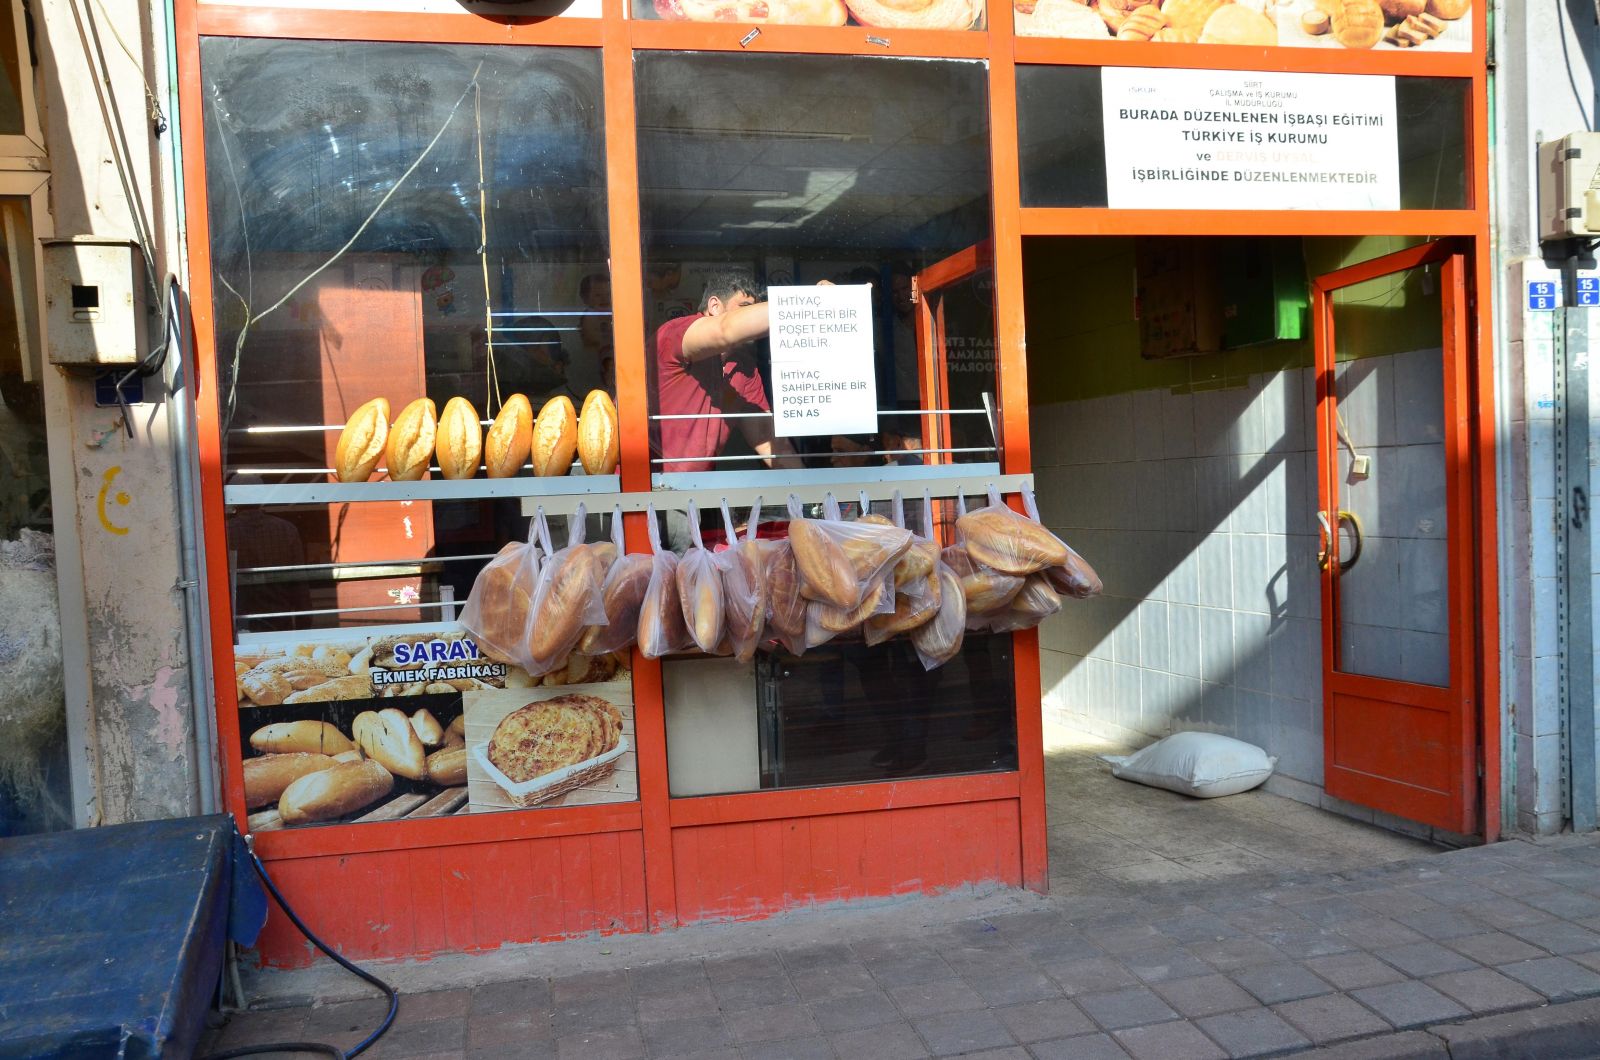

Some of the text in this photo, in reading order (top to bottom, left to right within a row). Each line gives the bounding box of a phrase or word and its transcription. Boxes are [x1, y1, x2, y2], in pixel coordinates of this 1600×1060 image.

[1264, 91, 1298, 100] KURUMU
[1119, 109, 1384, 127] BURADA DÜZENLENEN İŞBAŞI EĞİTİMİ
[1181, 128, 1328, 146] TÜRKİYE İŞ KURUMU
[1196, 153, 1212, 162] ve
[1132, 168, 1378, 184] İŞBİRLİĞİNDE DÜZENLENMEKTEDİR
[1536, 283, 1548, 294] 15
[1581, 279, 1593, 290] 15
[777, 295, 821, 308] İHTİYAÇ
[1538, 297, 1546, 308] B
[1582, 293, 1591, 304] C
[778, 307, 858, 321] SAHİPLERİ BİR
[778, 323, 858, 337] POŞET EKMEK
[779, 336, 832, 349] ALABİLİR.
[780, 369, 821, 381] İHTİYAÇ
[781, 380, 867, 393] SAHİPLERİNE BİR
[782, 395, 832, 406] POŞET DE
[783, 408, 821, 419] SEN AS
[393, 639, 480, 664] SARAY
[372, 664, 506, 684] EKMEK FABRİKASI
